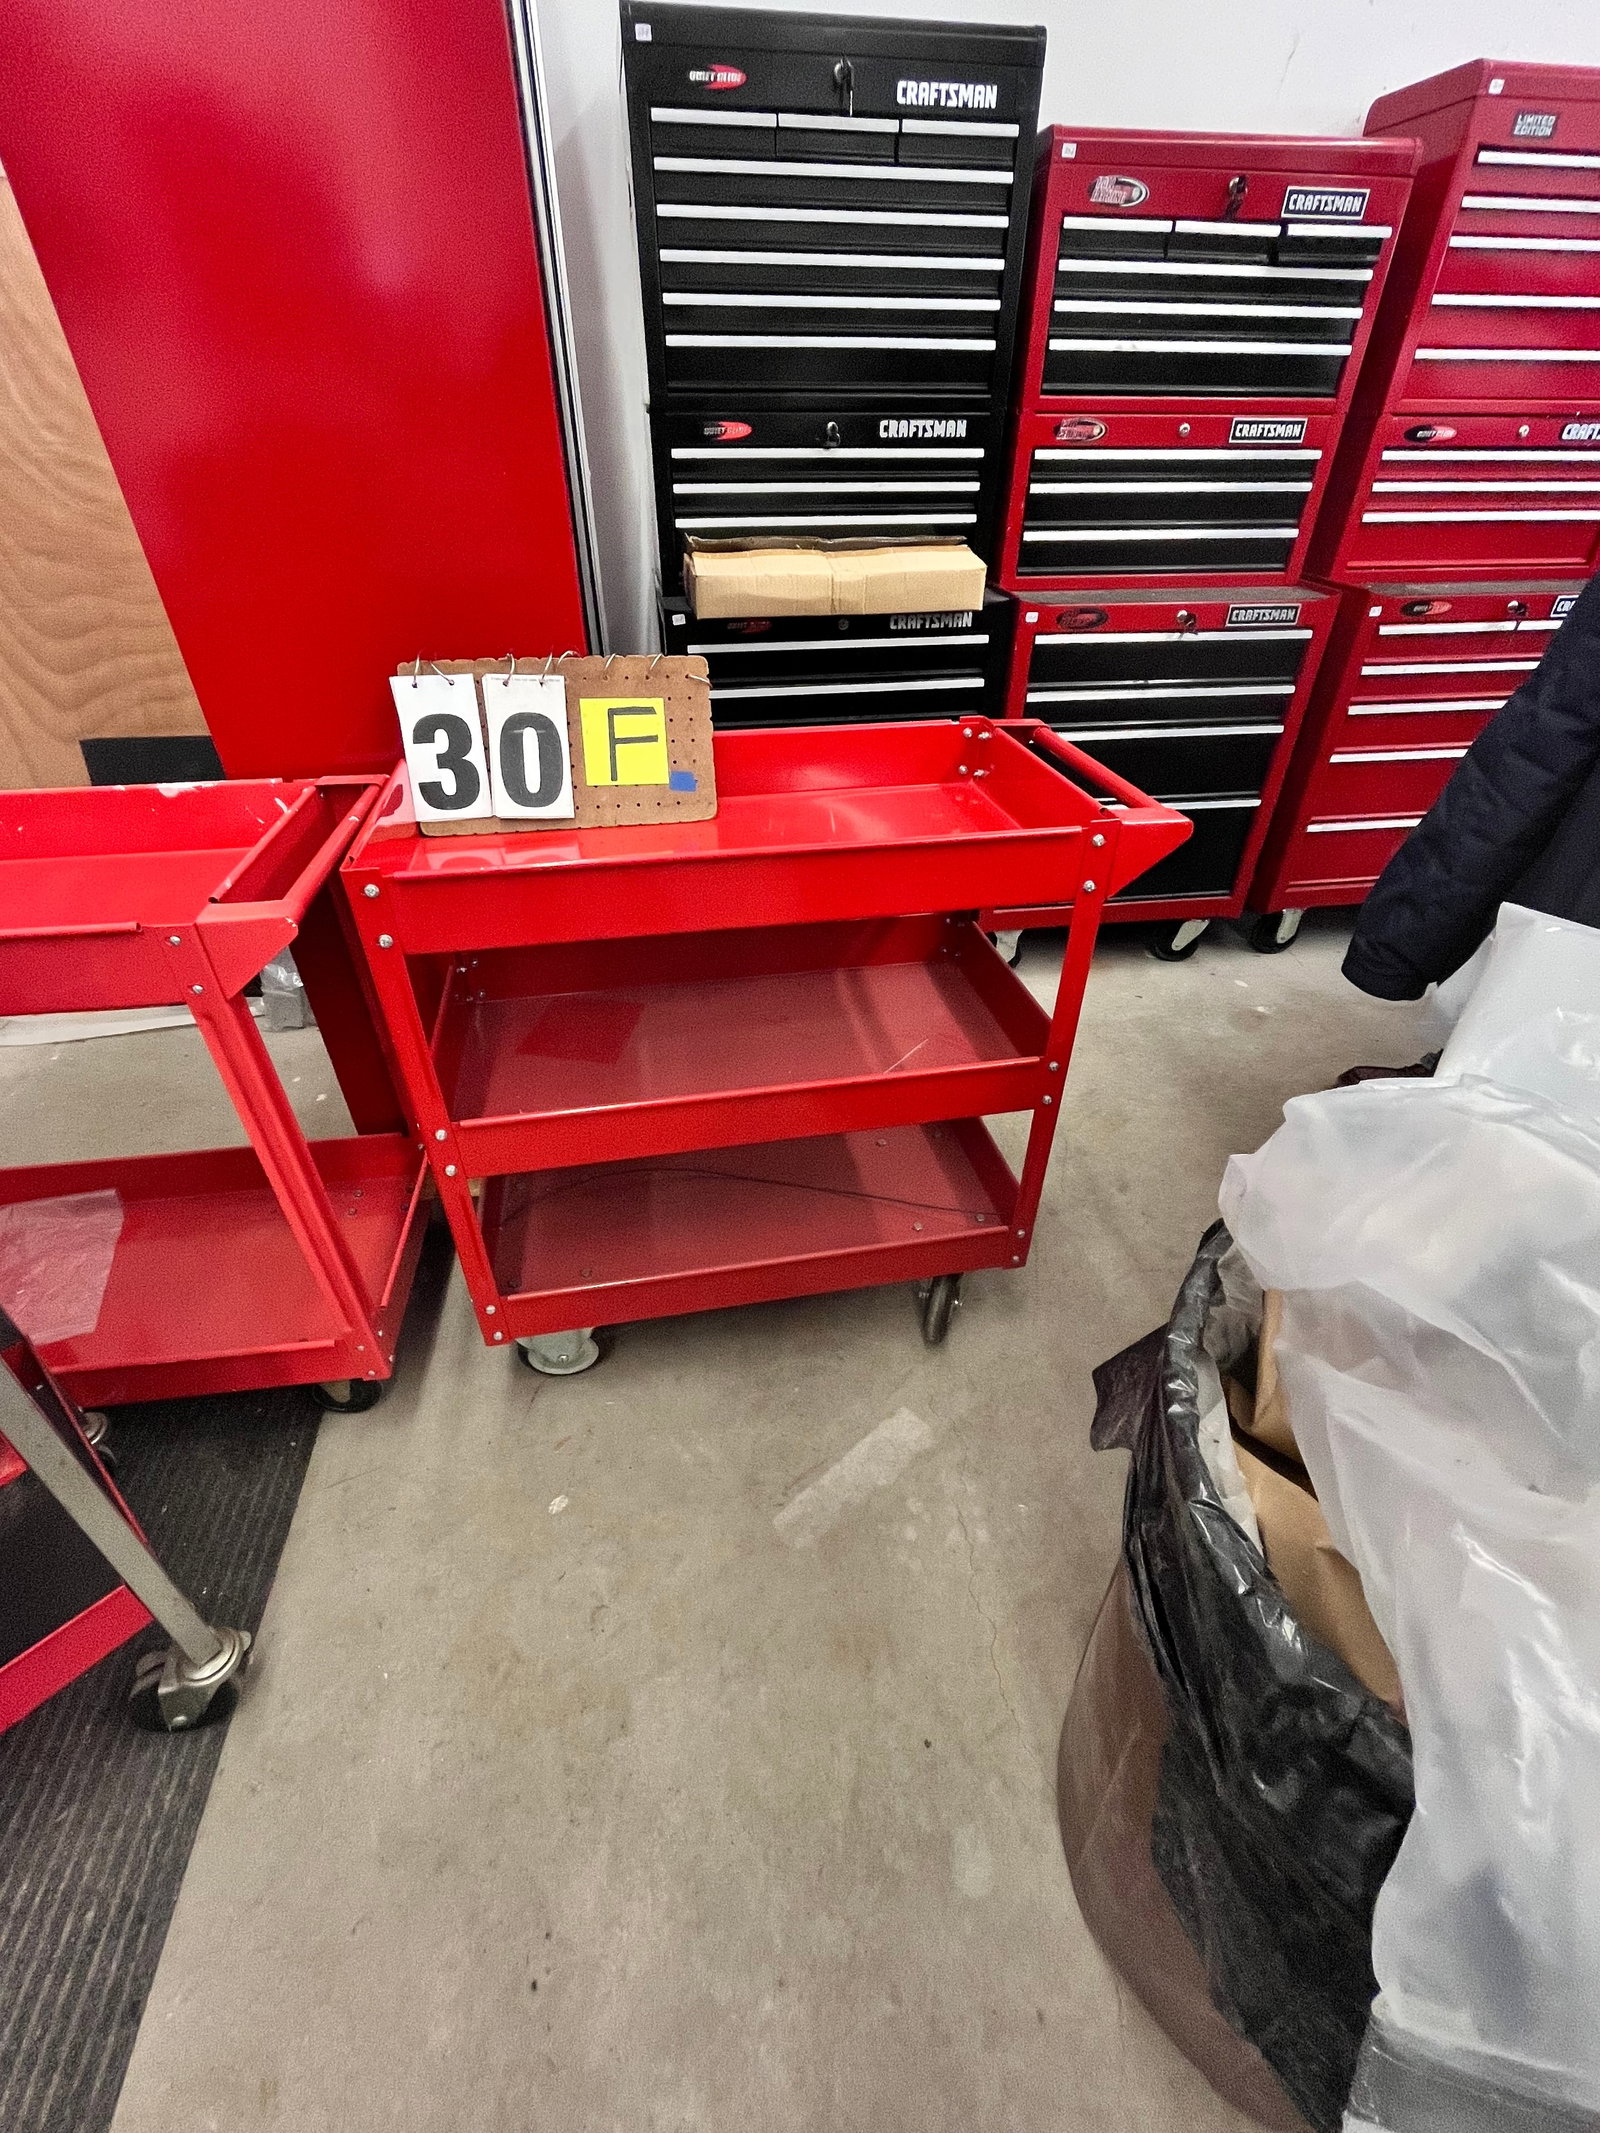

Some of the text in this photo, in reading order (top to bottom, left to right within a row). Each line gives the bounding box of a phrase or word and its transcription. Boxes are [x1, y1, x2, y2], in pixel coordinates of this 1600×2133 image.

[896, 80, 998, 109] CRAFTSMAN
[1517, 114, 1556, 126] LIMITED
[1513, 125, 1553, 137] EDITION
[1288, 194, 1363, 213] CRAFTSMAN
[879, 419, 967, 438] CRAFTSMAN
[1235, 423, 1302, 438] CRAFTSMAN
[889, 611, 973, 630] CRAFTSMAN
[1231, 608, 1297, 622] CRAFTSMAN
[412, 706, 659, 811] 30 F
